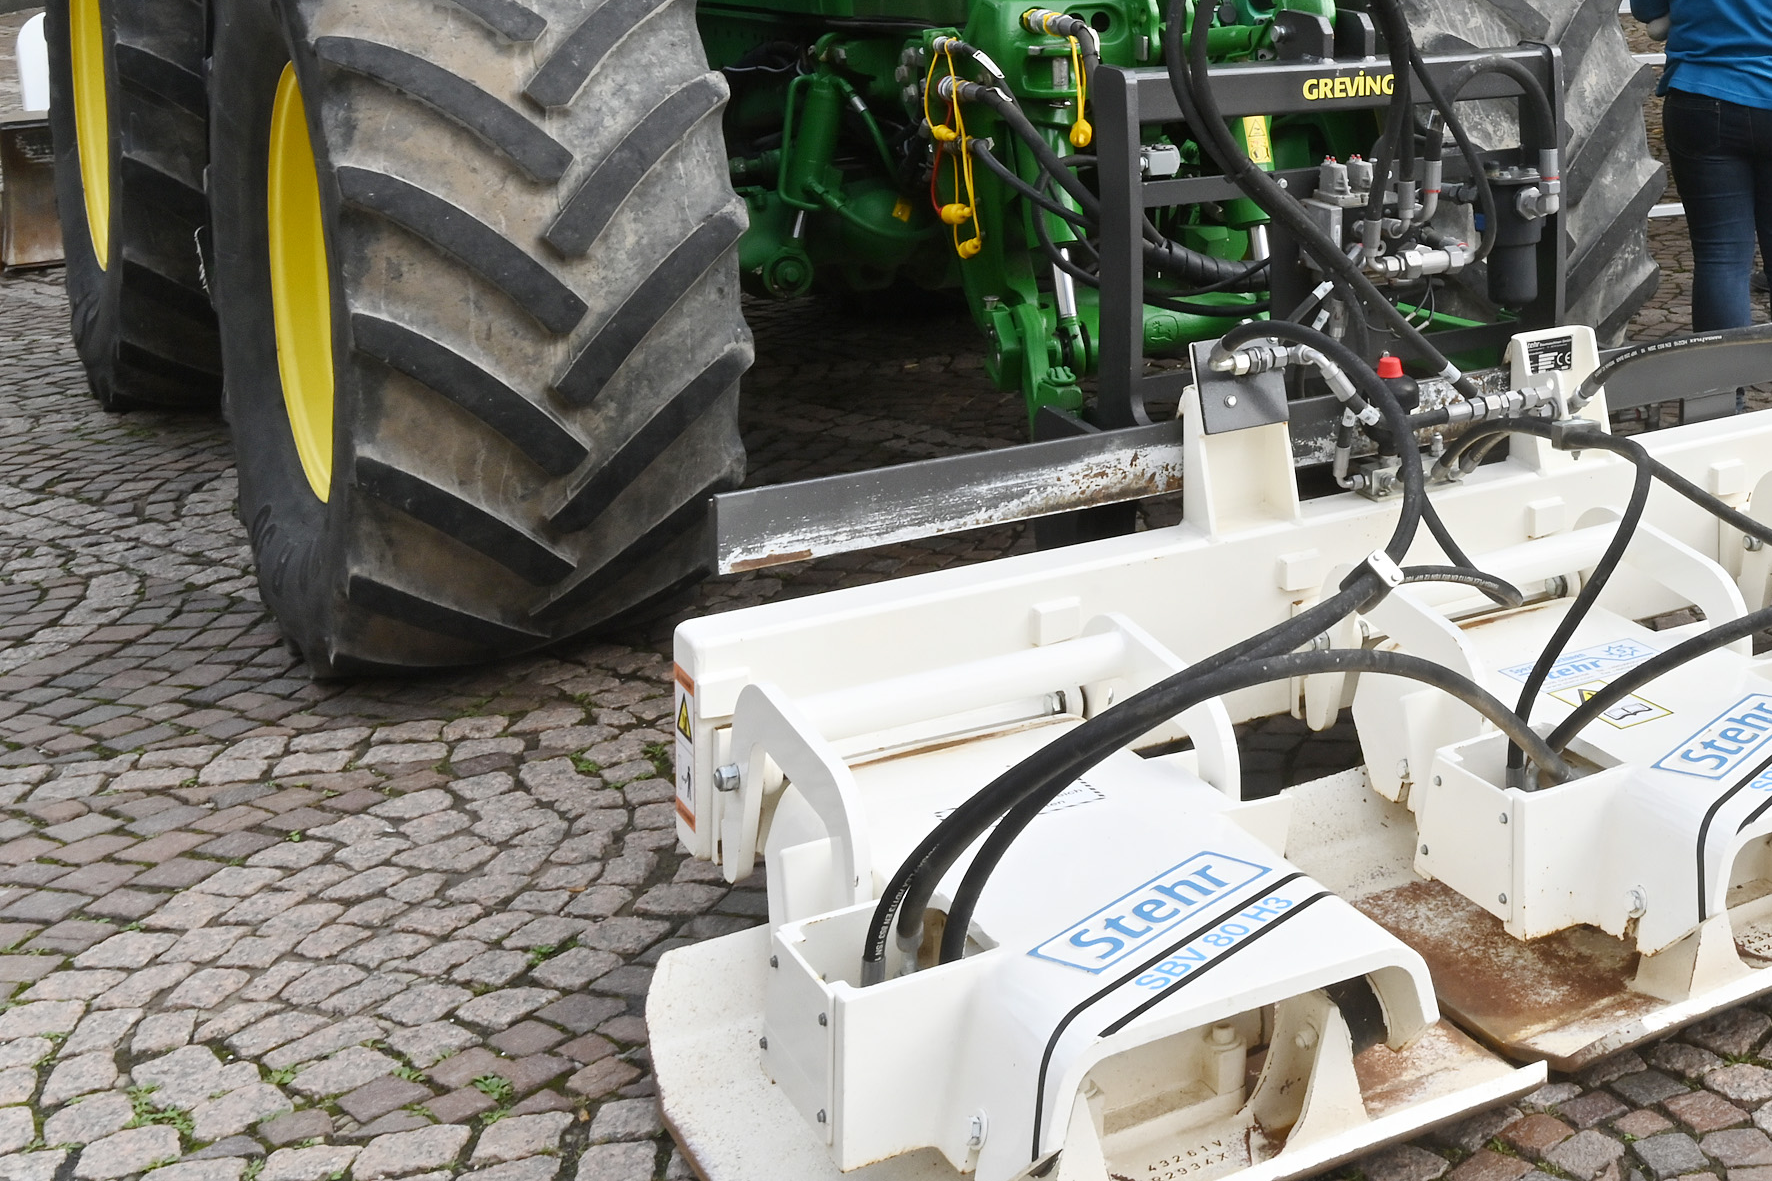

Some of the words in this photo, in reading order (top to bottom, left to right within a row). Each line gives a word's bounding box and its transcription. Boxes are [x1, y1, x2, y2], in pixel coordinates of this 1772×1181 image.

[1302, 70, 1395, 101] GREVING
[1544, 659, 1604, 680] tehr
[1069, 864, 1230, 960] Stehr
[1134, 946, 1209, 990] SBV
[1202, 923, 1250, 947] 80
[1240, 896, 1293, 923] H3
